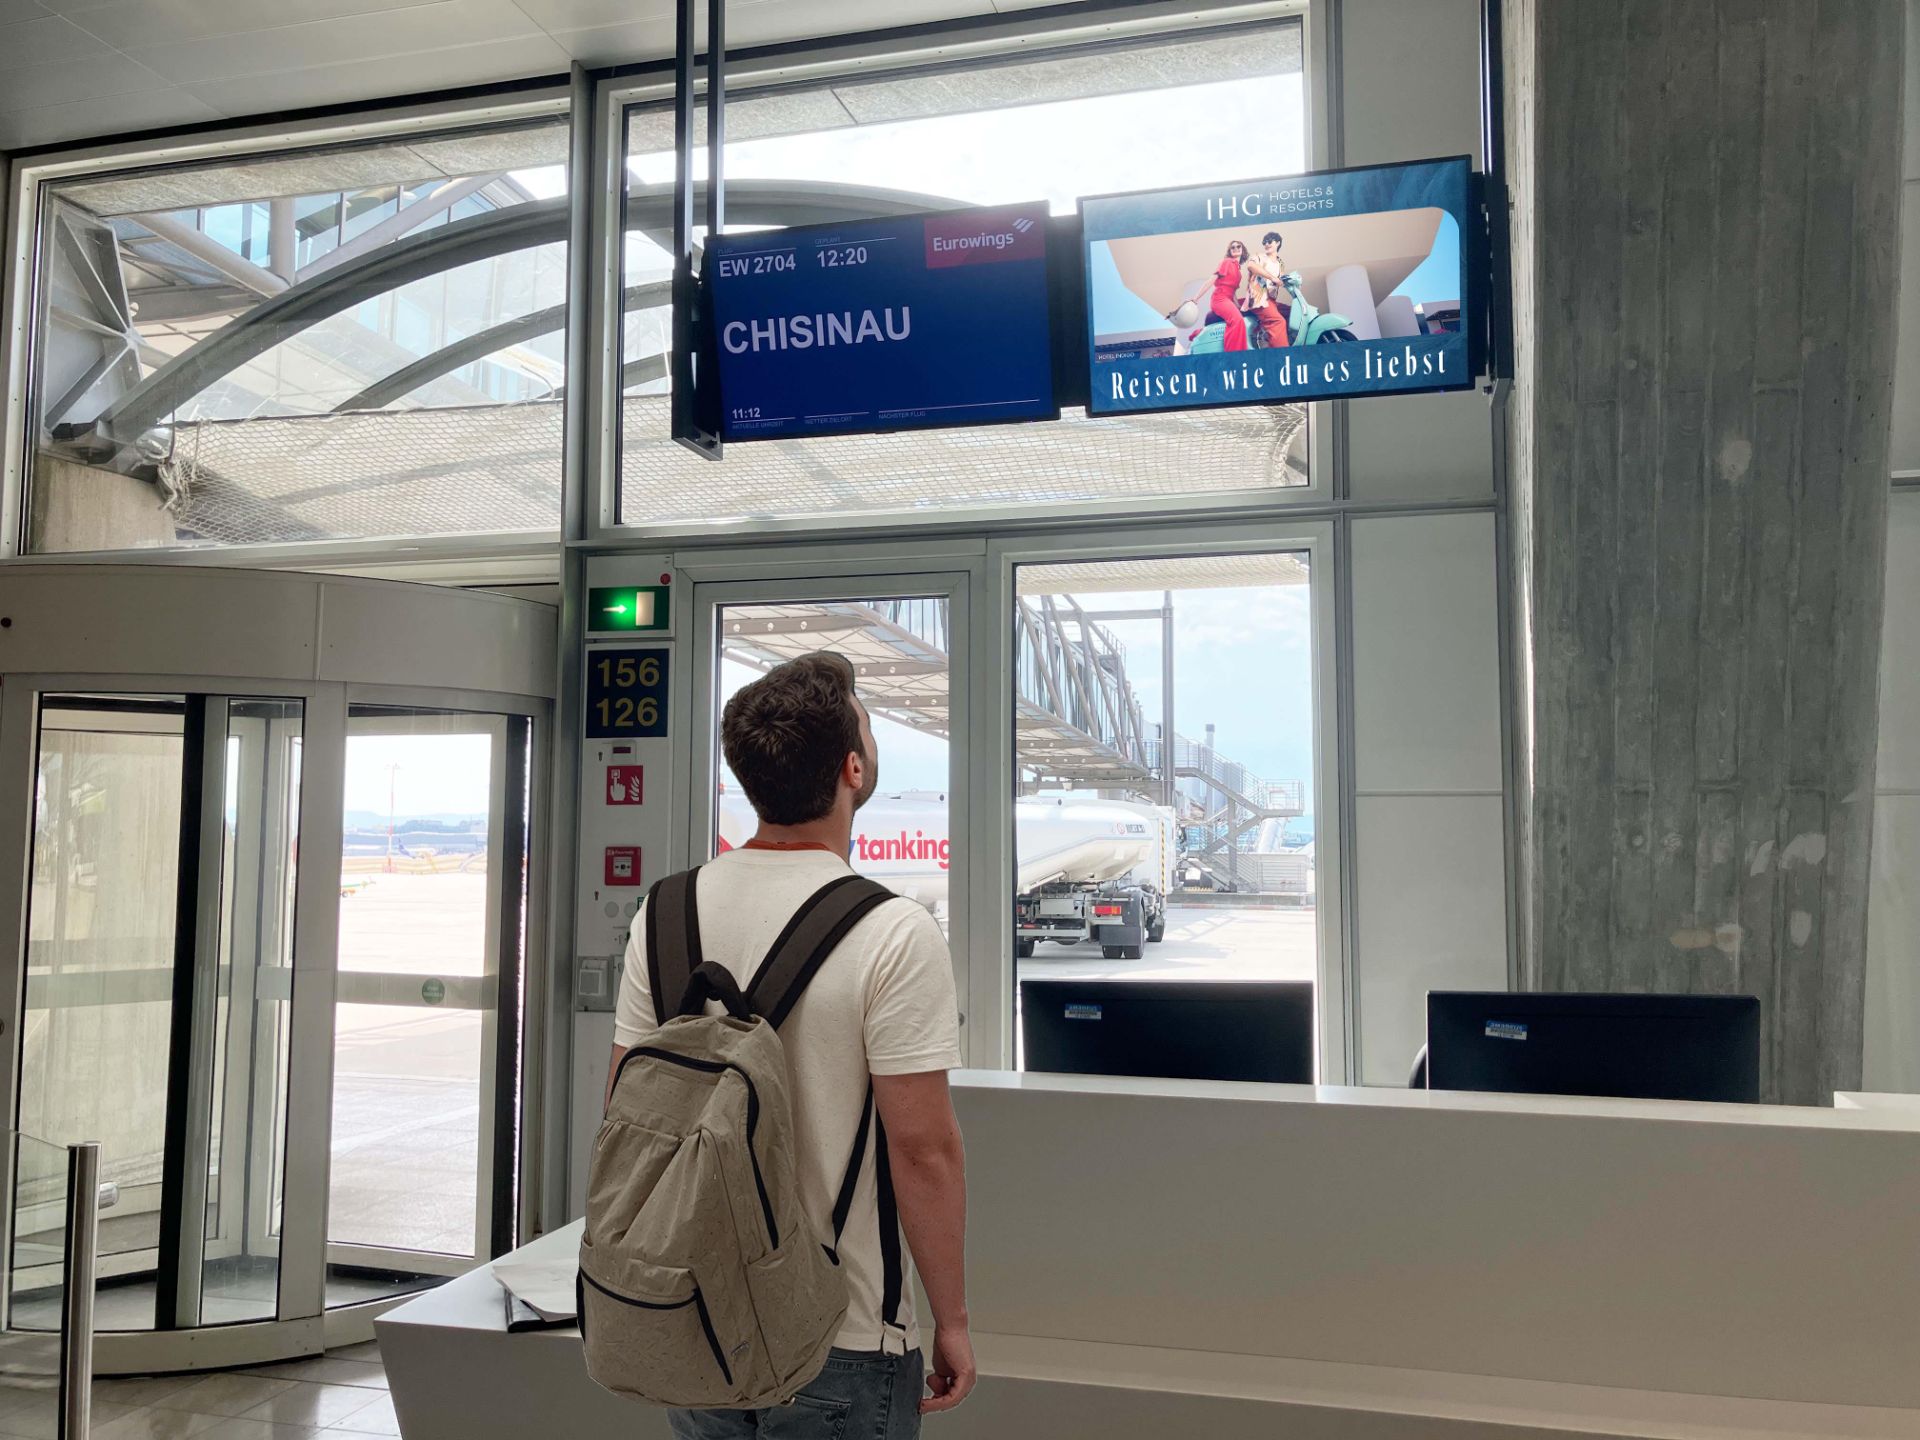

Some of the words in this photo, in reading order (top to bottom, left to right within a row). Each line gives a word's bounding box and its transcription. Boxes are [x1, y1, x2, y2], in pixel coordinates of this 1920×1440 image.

[1269, 187, 1323, 202] HOTELS
[1325, 185, 1335, 196] &
[1269, 199, 1335, 214] RESORTS
[1207, 193, 1261, 221] IHG
[932, 230, 1015, 252] Eurowings
[718, 257, 749, 278] EW
[753, 253, 797, 274] 2704
[816, 246, 868, 268] 12:20
[723, 306, 911, 354] CHISINAU
[1111, 369, 1208, 400] Reisen,
[1222, 364, 1265, 391] wie
[1280, 356, 1309, 387] du
[1323, 359, 1351, 383] es
[1365, 346, 1447, 380] liebst
[732, 407, 761, 419] 11:12
[597, 657, 661, 688] 156
[596, 697, 659, 727] 126
[849, 830, 950, 870] tanking
